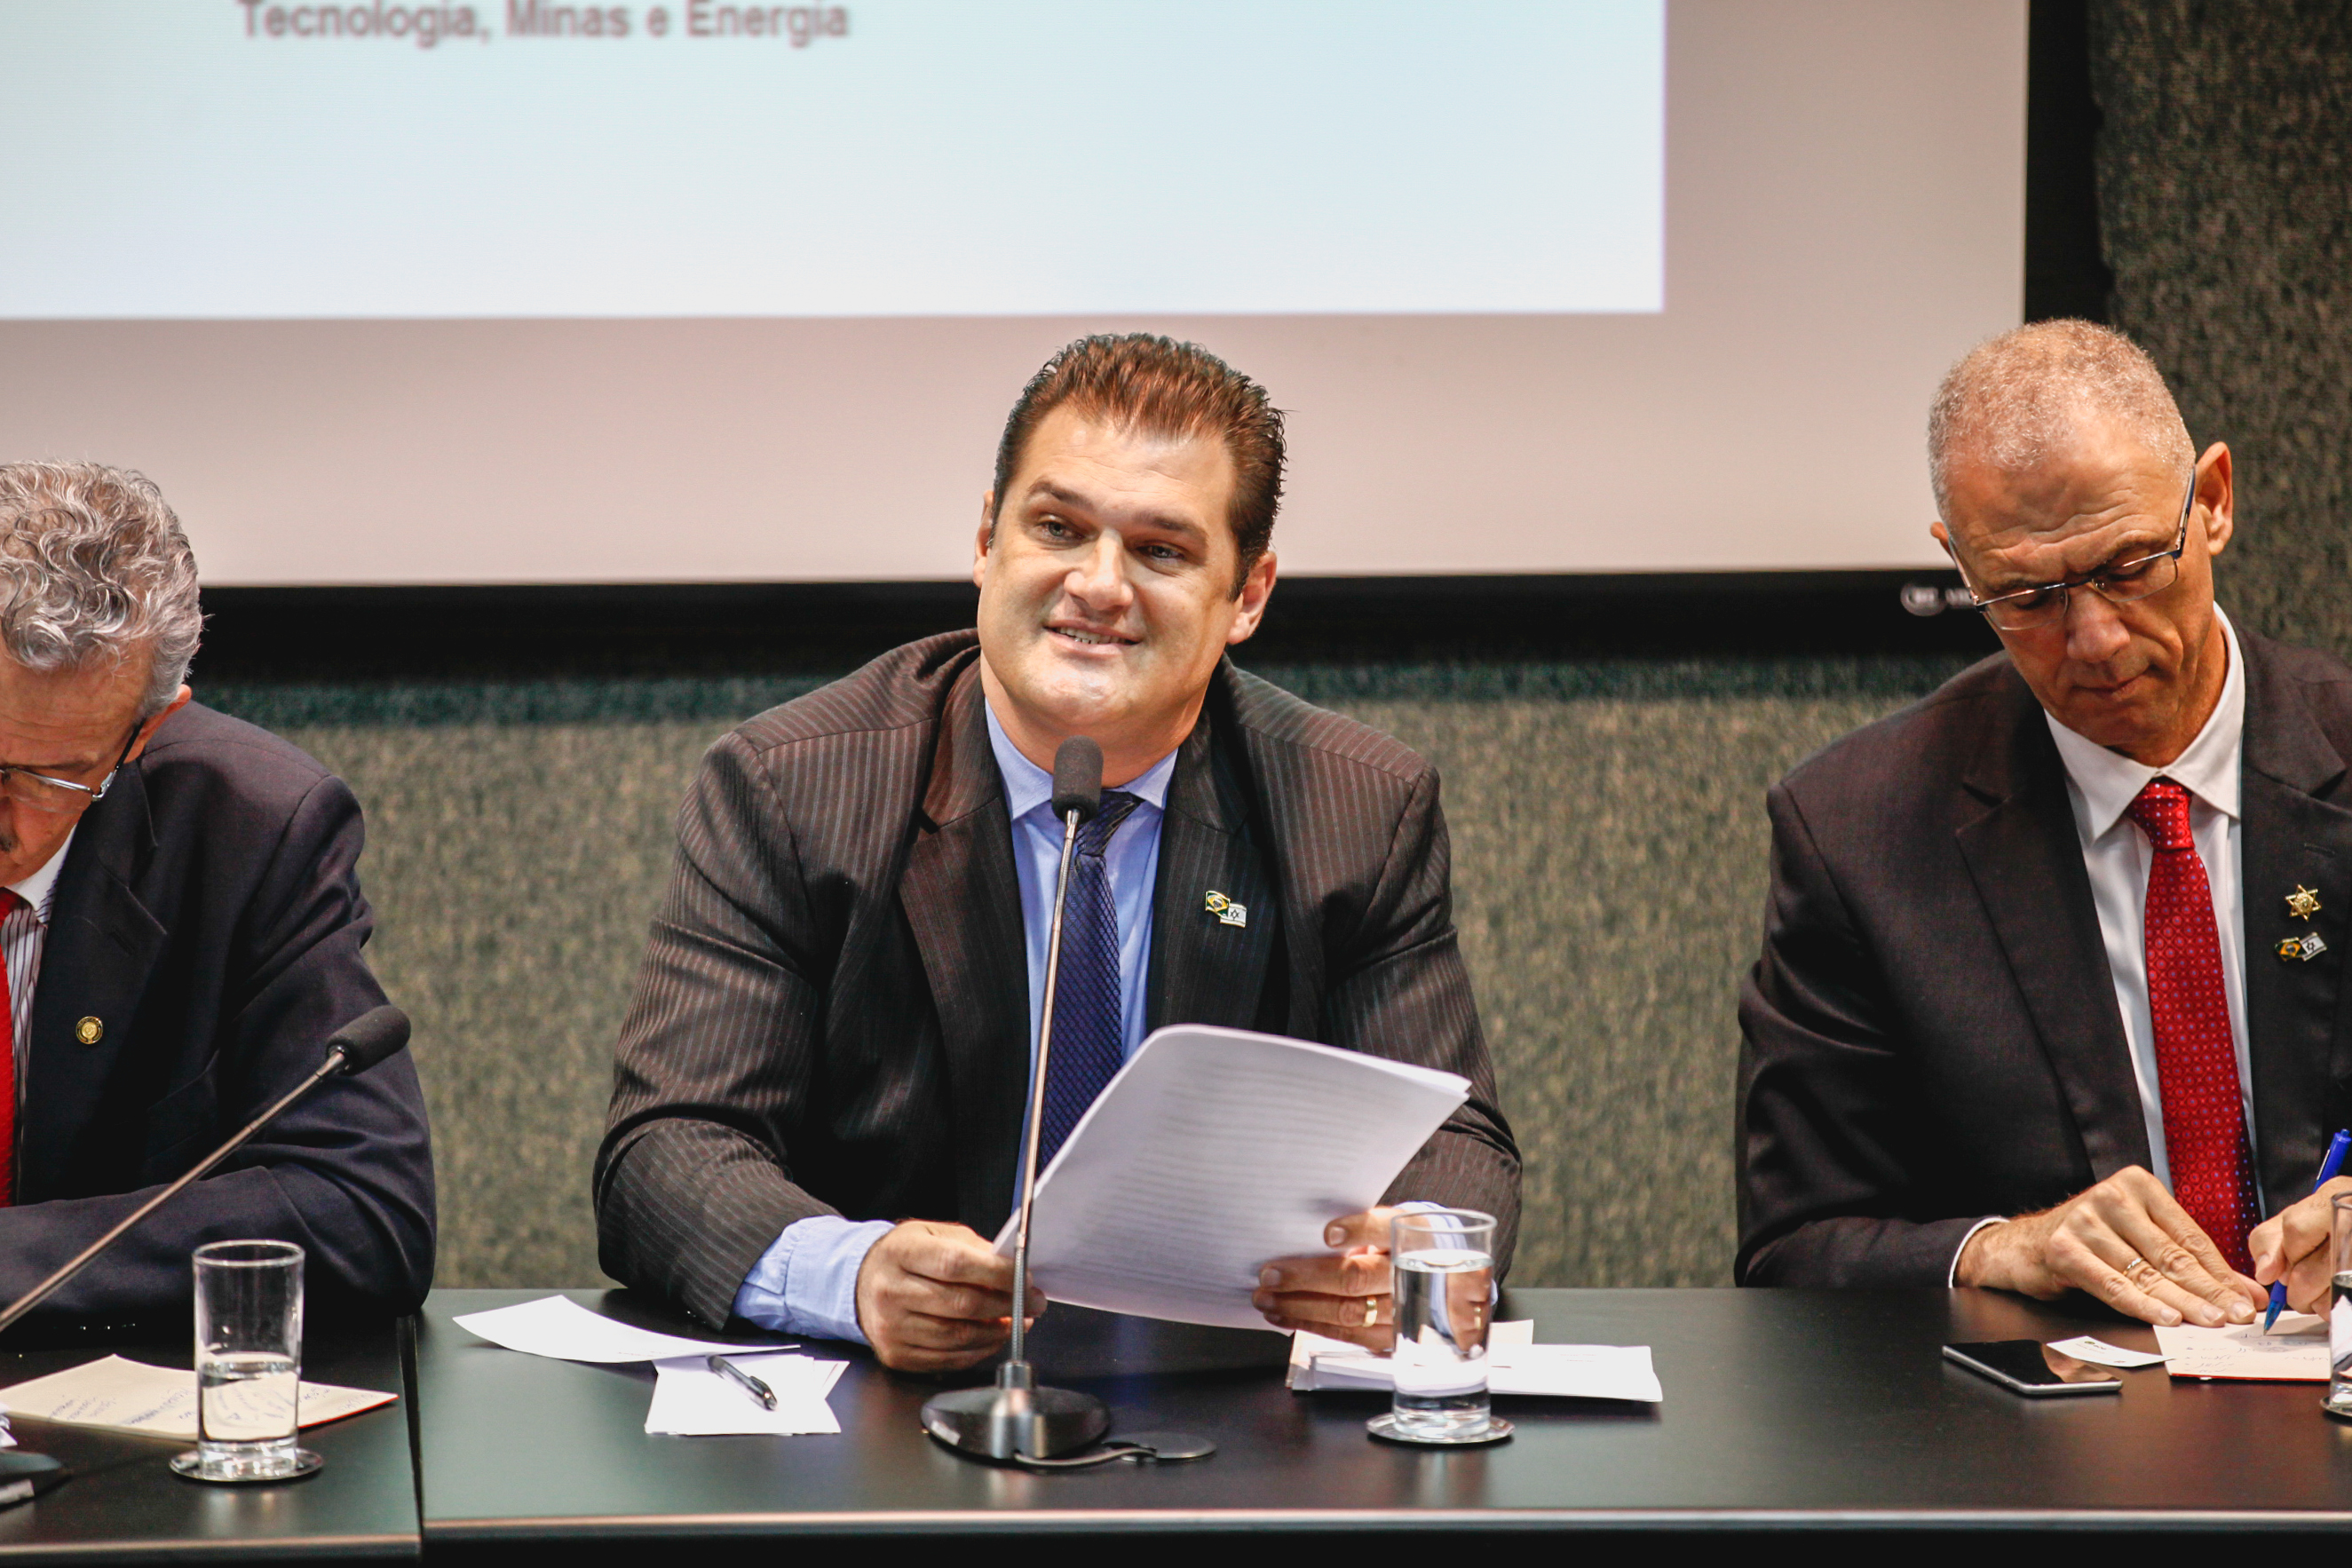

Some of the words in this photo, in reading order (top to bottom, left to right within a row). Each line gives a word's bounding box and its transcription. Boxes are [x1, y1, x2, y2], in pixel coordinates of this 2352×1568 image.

[236, 0, 490, 49] Tecnologia,
[505, 0, 631, 37] Minas
[645, 6, 669, 37] e
[685, 0, 850, 48] Energia
